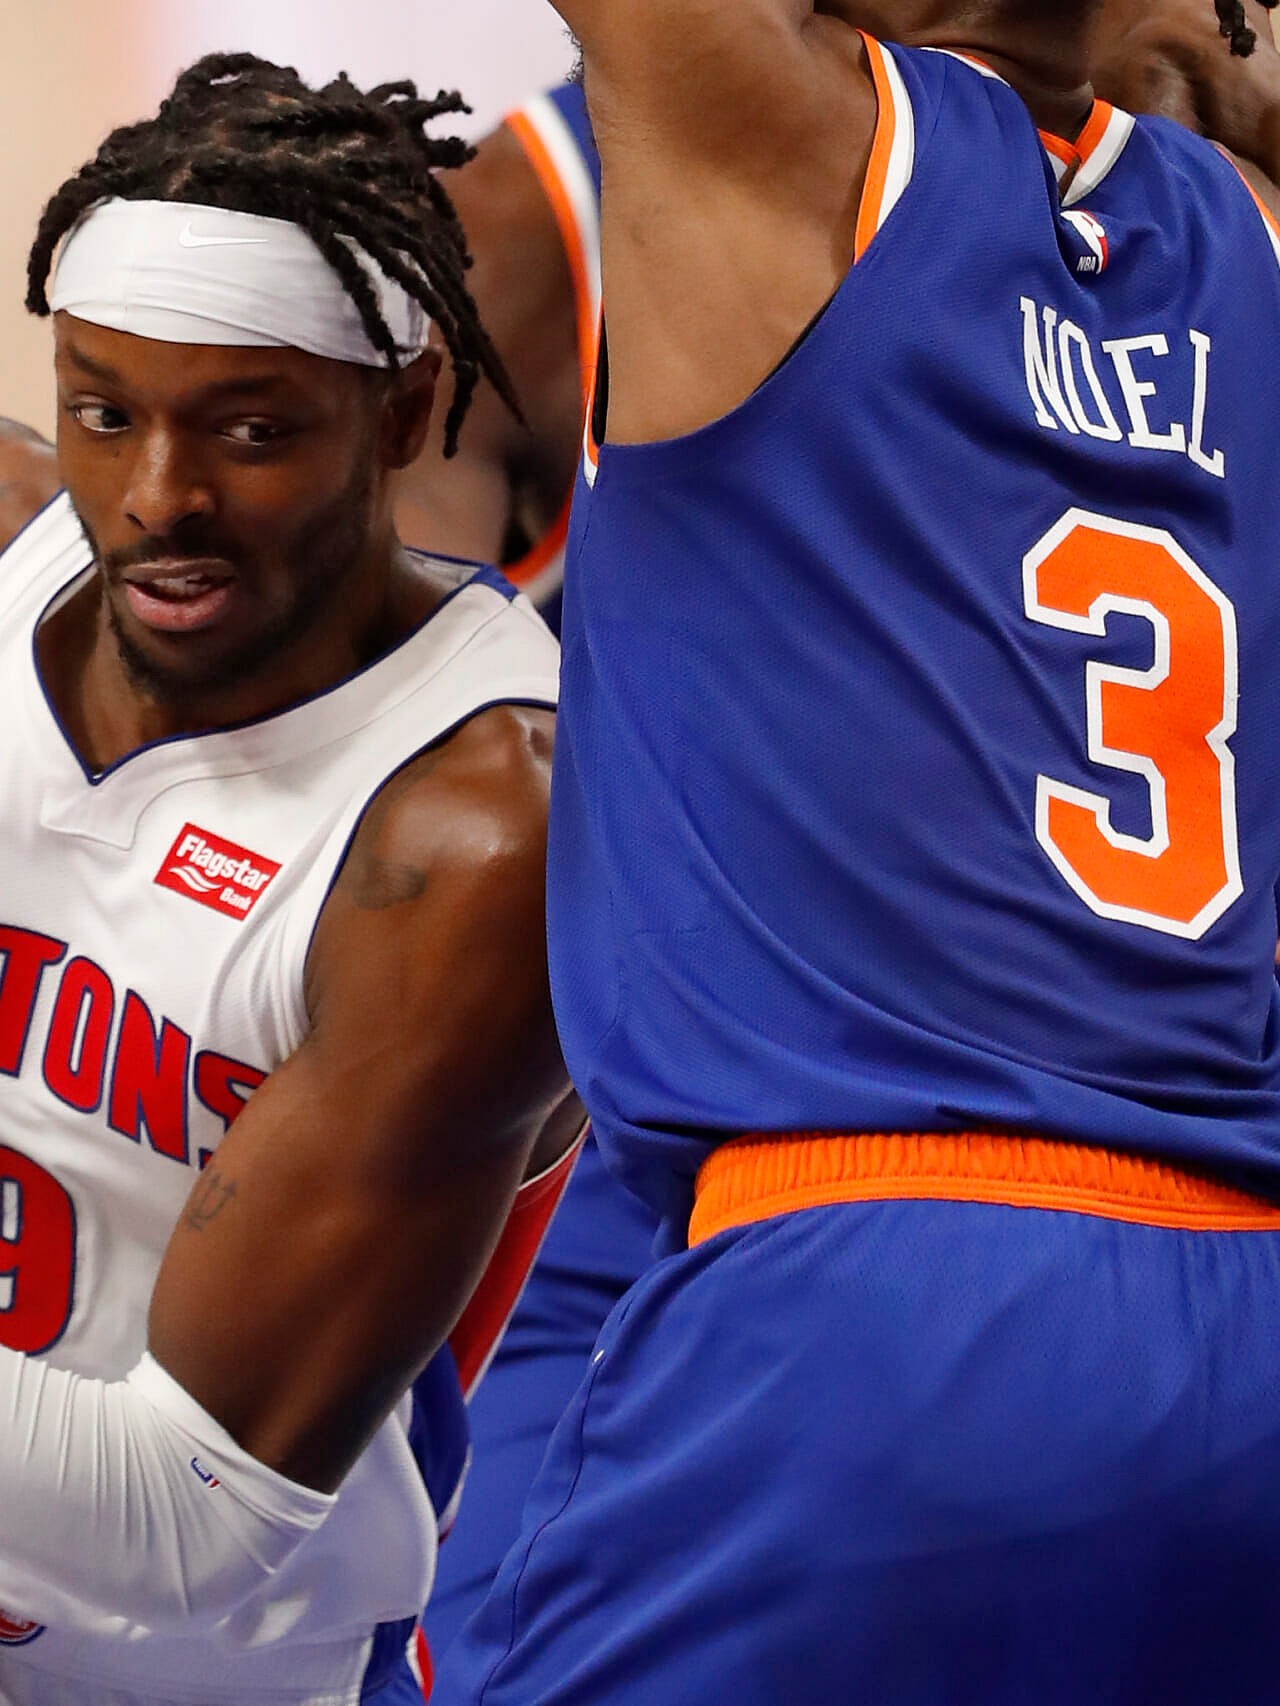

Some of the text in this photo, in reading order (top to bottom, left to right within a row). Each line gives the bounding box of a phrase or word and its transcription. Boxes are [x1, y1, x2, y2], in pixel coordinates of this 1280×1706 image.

[1076, 256, 1097, 272] NBA
[1020, 296, 1225, 478] NOEL
[1022, 506, 1245, 941] 3
[176, 833, 270, 891] Flagstar
[219, 886, 252, 911] Bank
